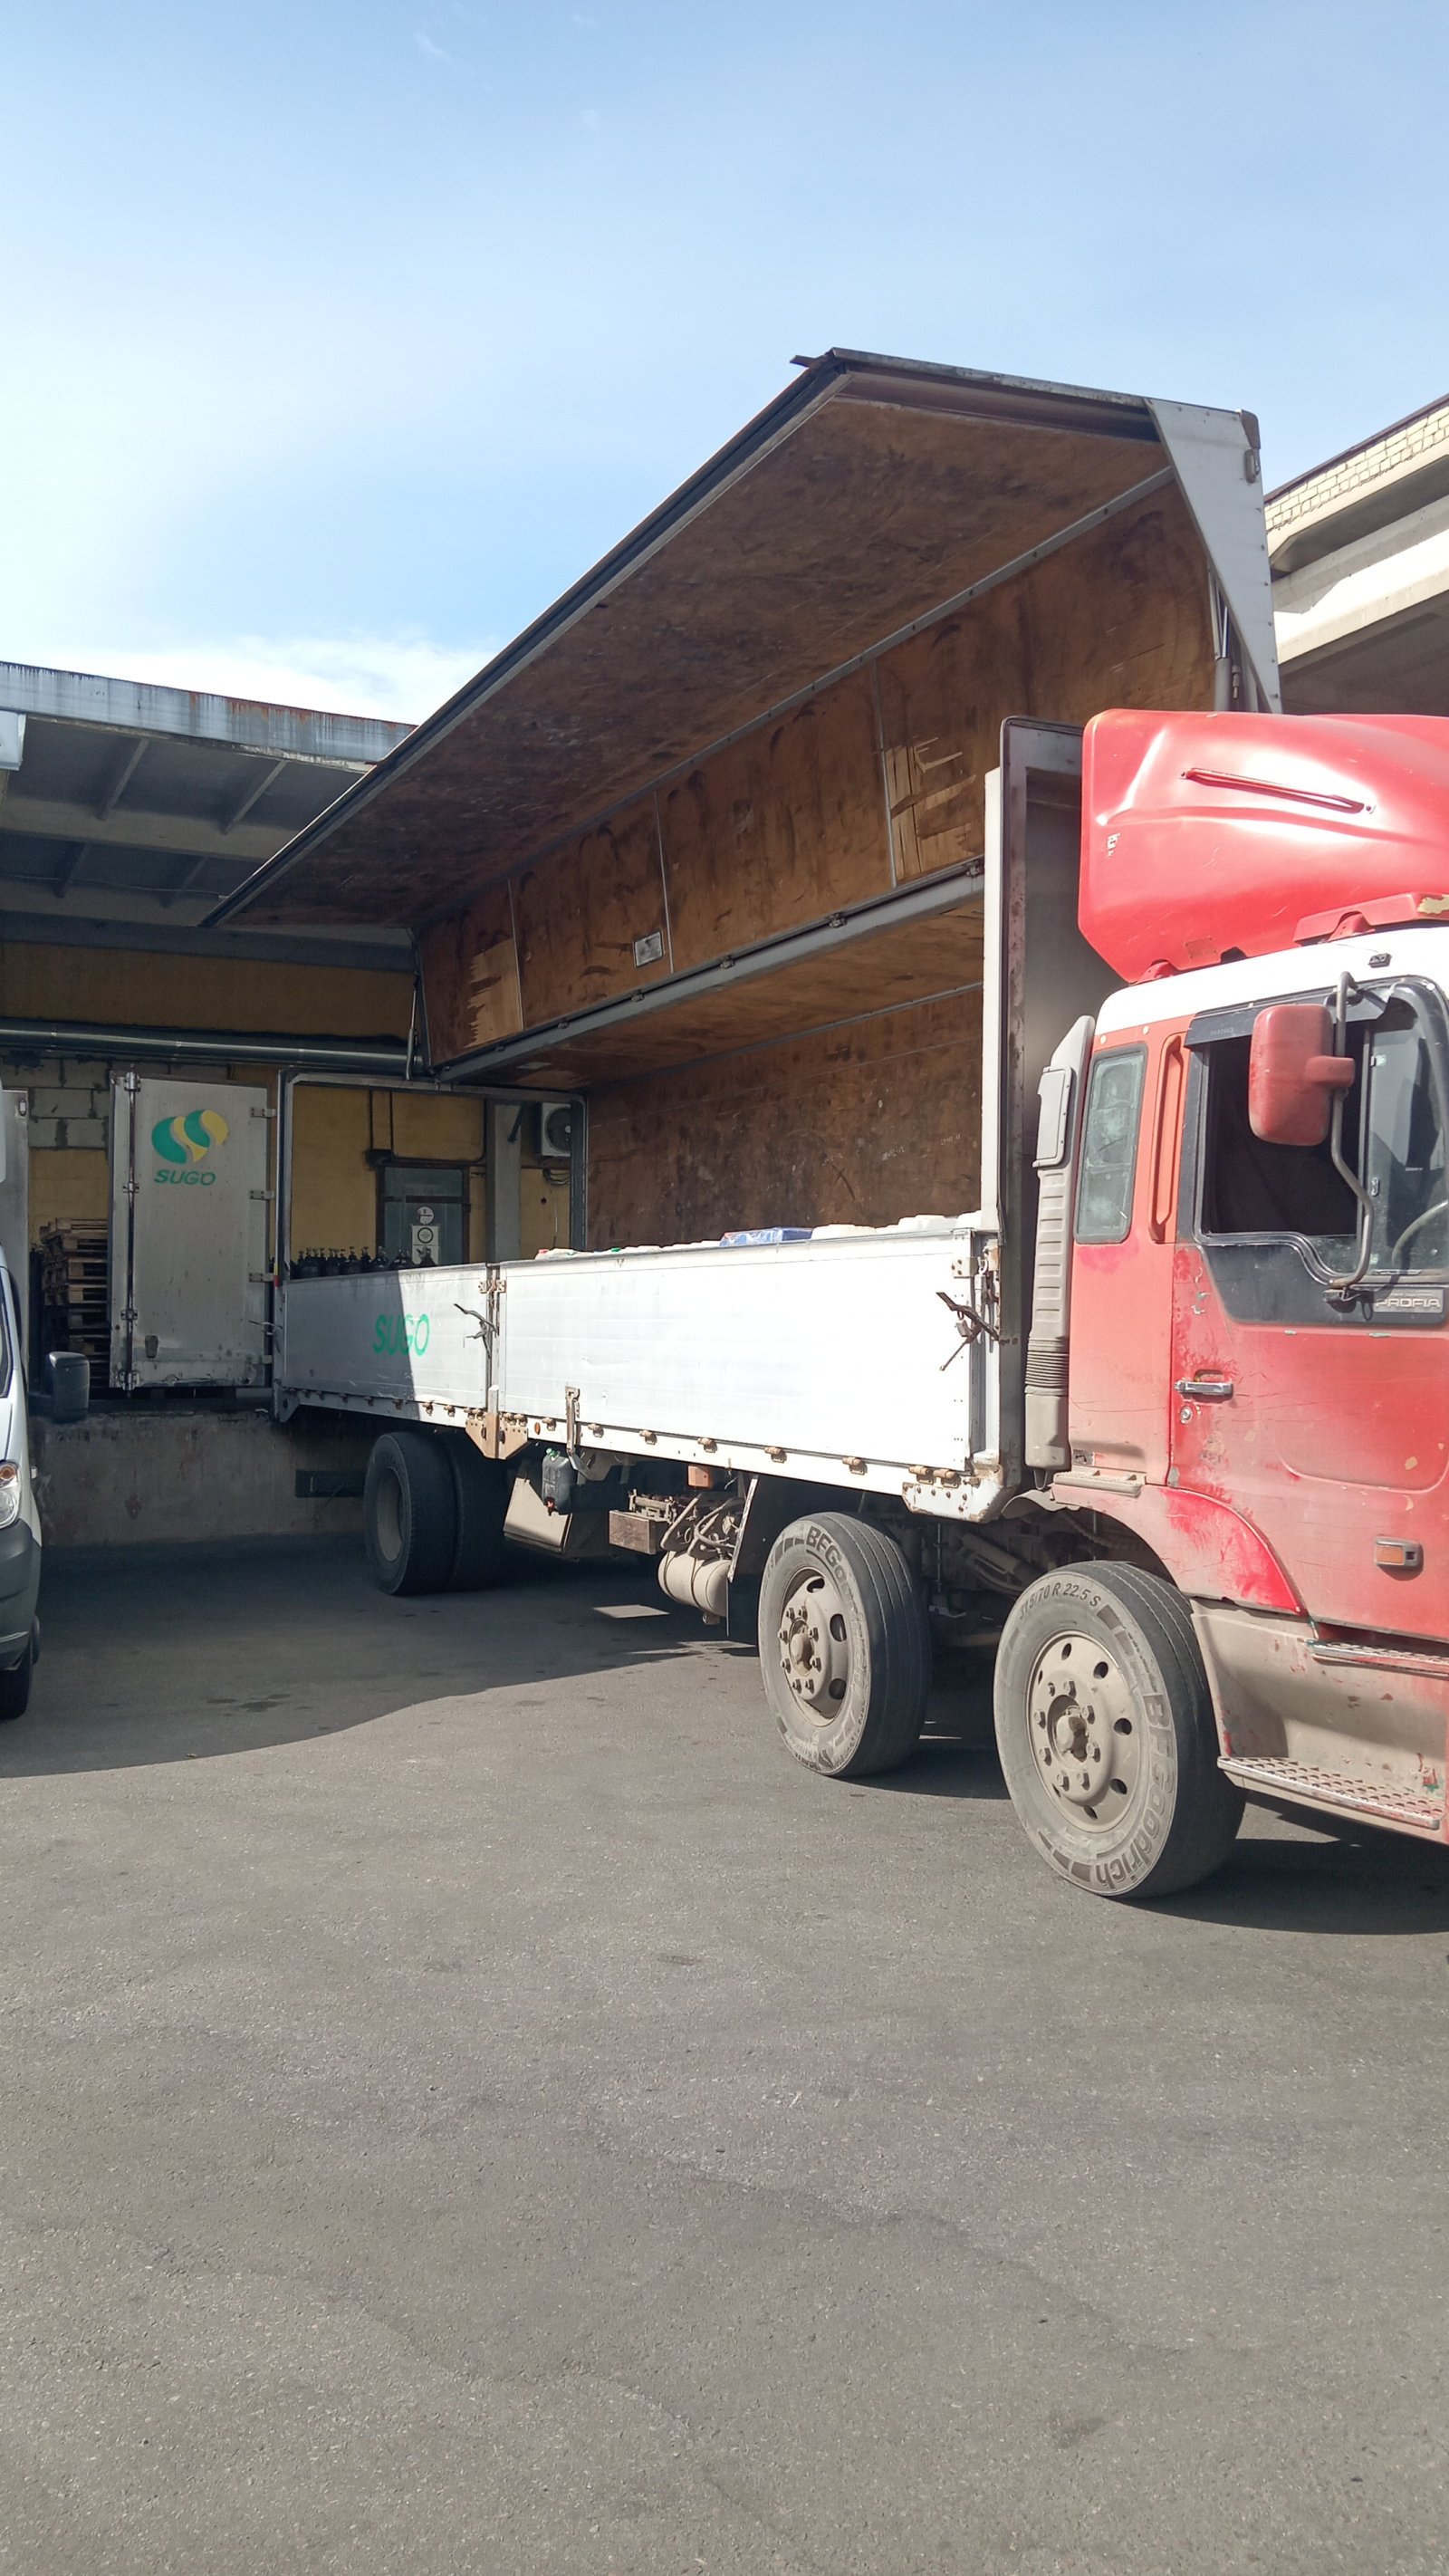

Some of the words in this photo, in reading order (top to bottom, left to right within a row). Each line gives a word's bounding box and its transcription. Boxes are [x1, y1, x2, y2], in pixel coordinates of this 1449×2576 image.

[153, 1169, 216, 1186] SUGO
[373, 1312, 430, 1357] SUGO
[1051, 1581, 1061, 1596] R
[1062, 1582, 1091, 1600] 22.5
[1089, 1595, 1102, 1607] S
[1095, 1694, 1176, 1891] BFGoodrich
